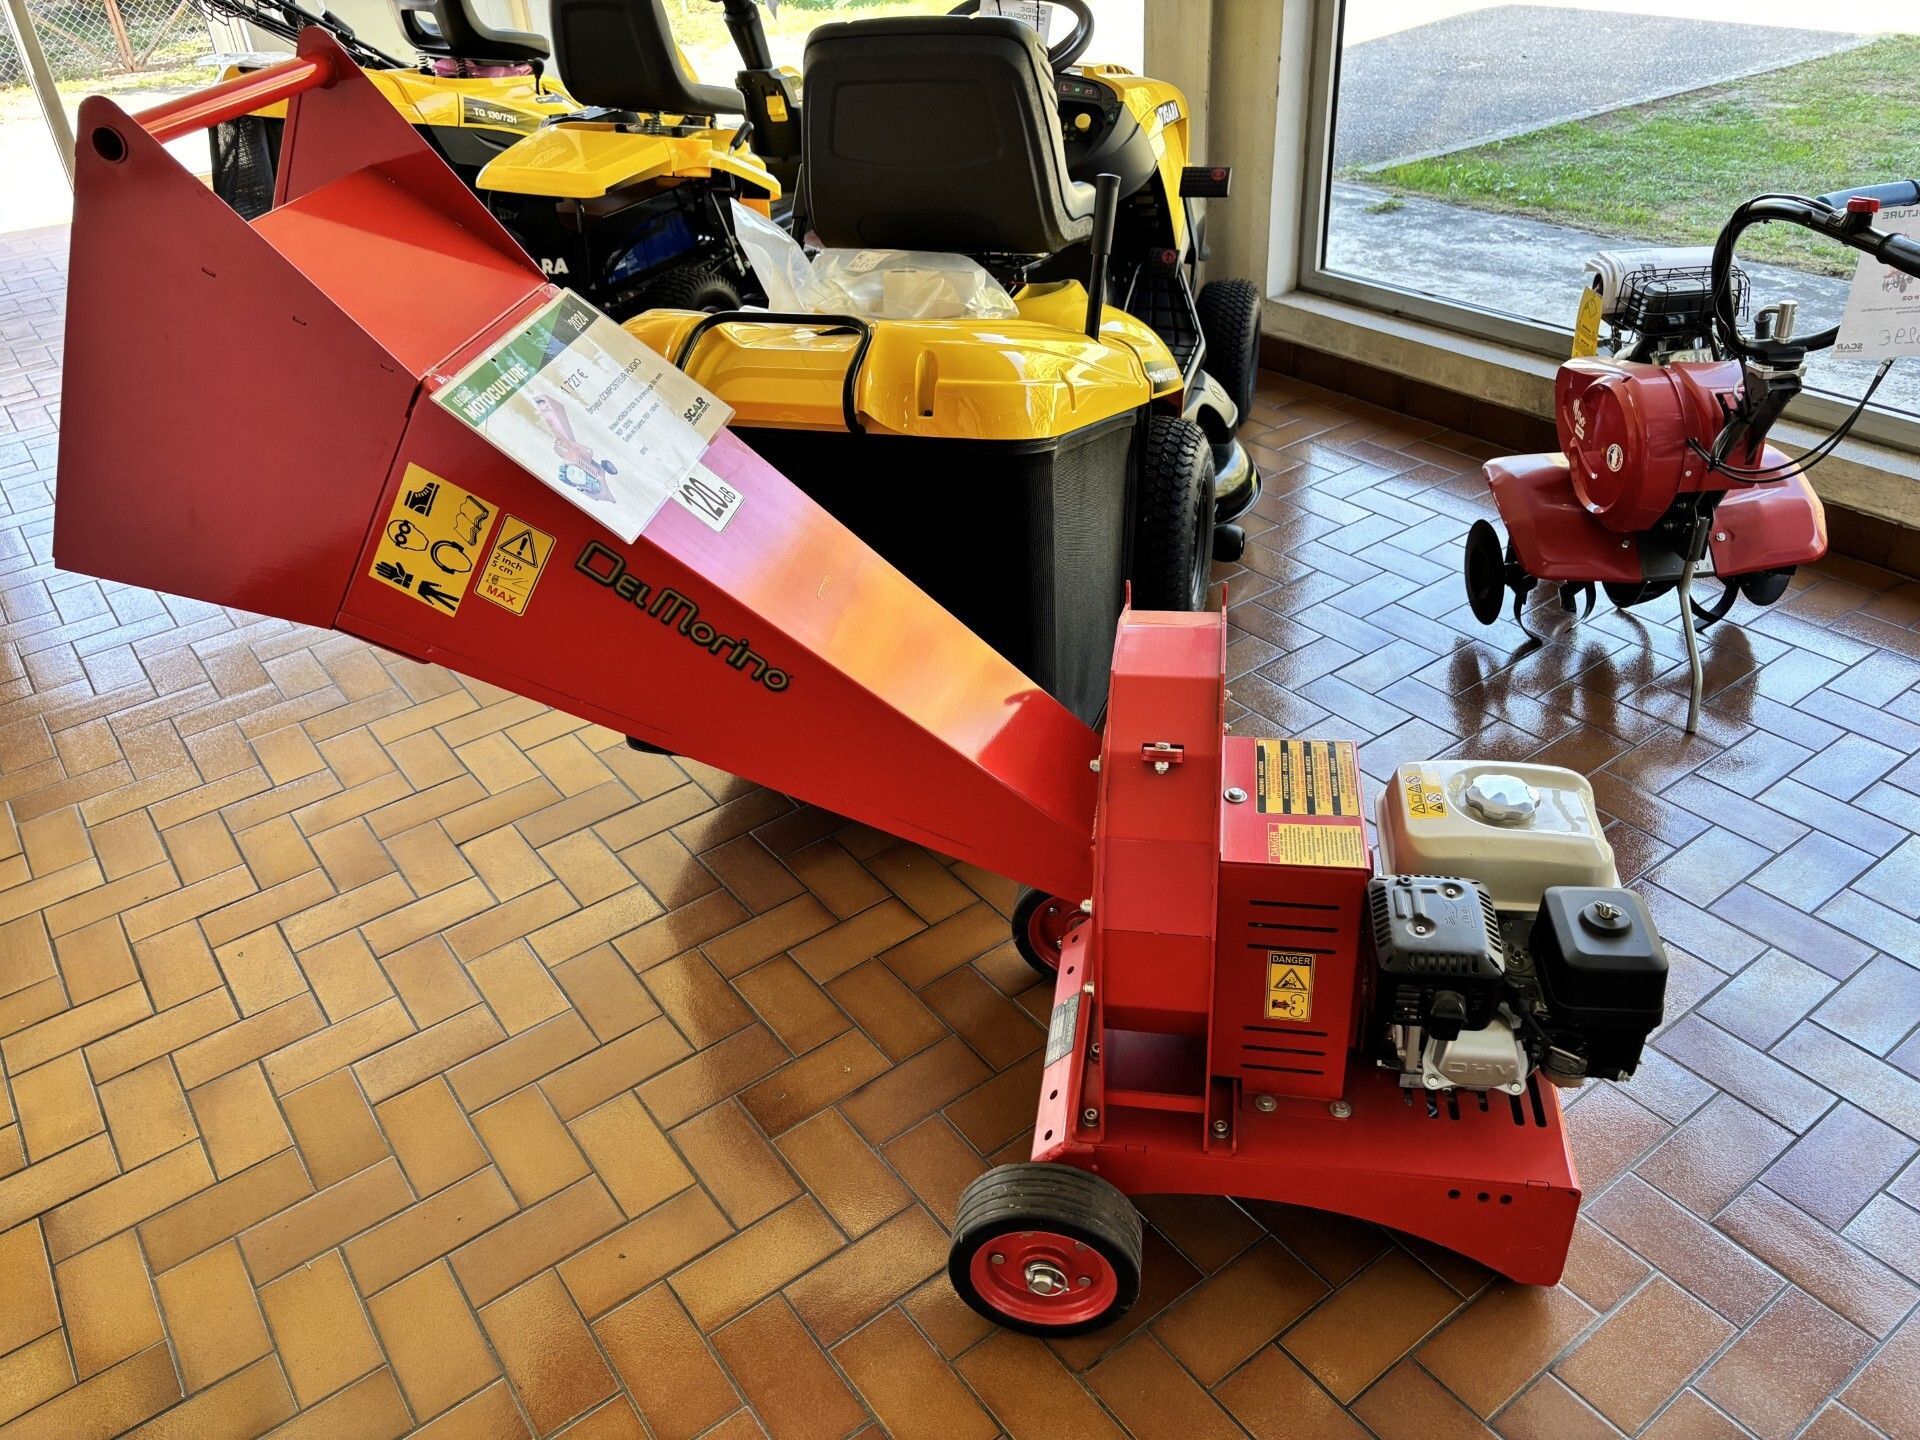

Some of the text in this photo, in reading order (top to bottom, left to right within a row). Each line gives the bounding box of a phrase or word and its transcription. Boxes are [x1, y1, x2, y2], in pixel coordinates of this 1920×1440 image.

[487, 110, 517, 124] 130/72H
[567, 310, 590, 331] 2024
[462, 362, 529, 420] MOTOCULTURE
[684, 397, 706, 422] SCAR
[499, 565, 513, 575] cm
[502, 556, 522, 571] inch
[486, 585, 516, 605] MAX
[1270, 831, 1279, 856] DANGER
[1272, 955, 1310, 965] DANGER
